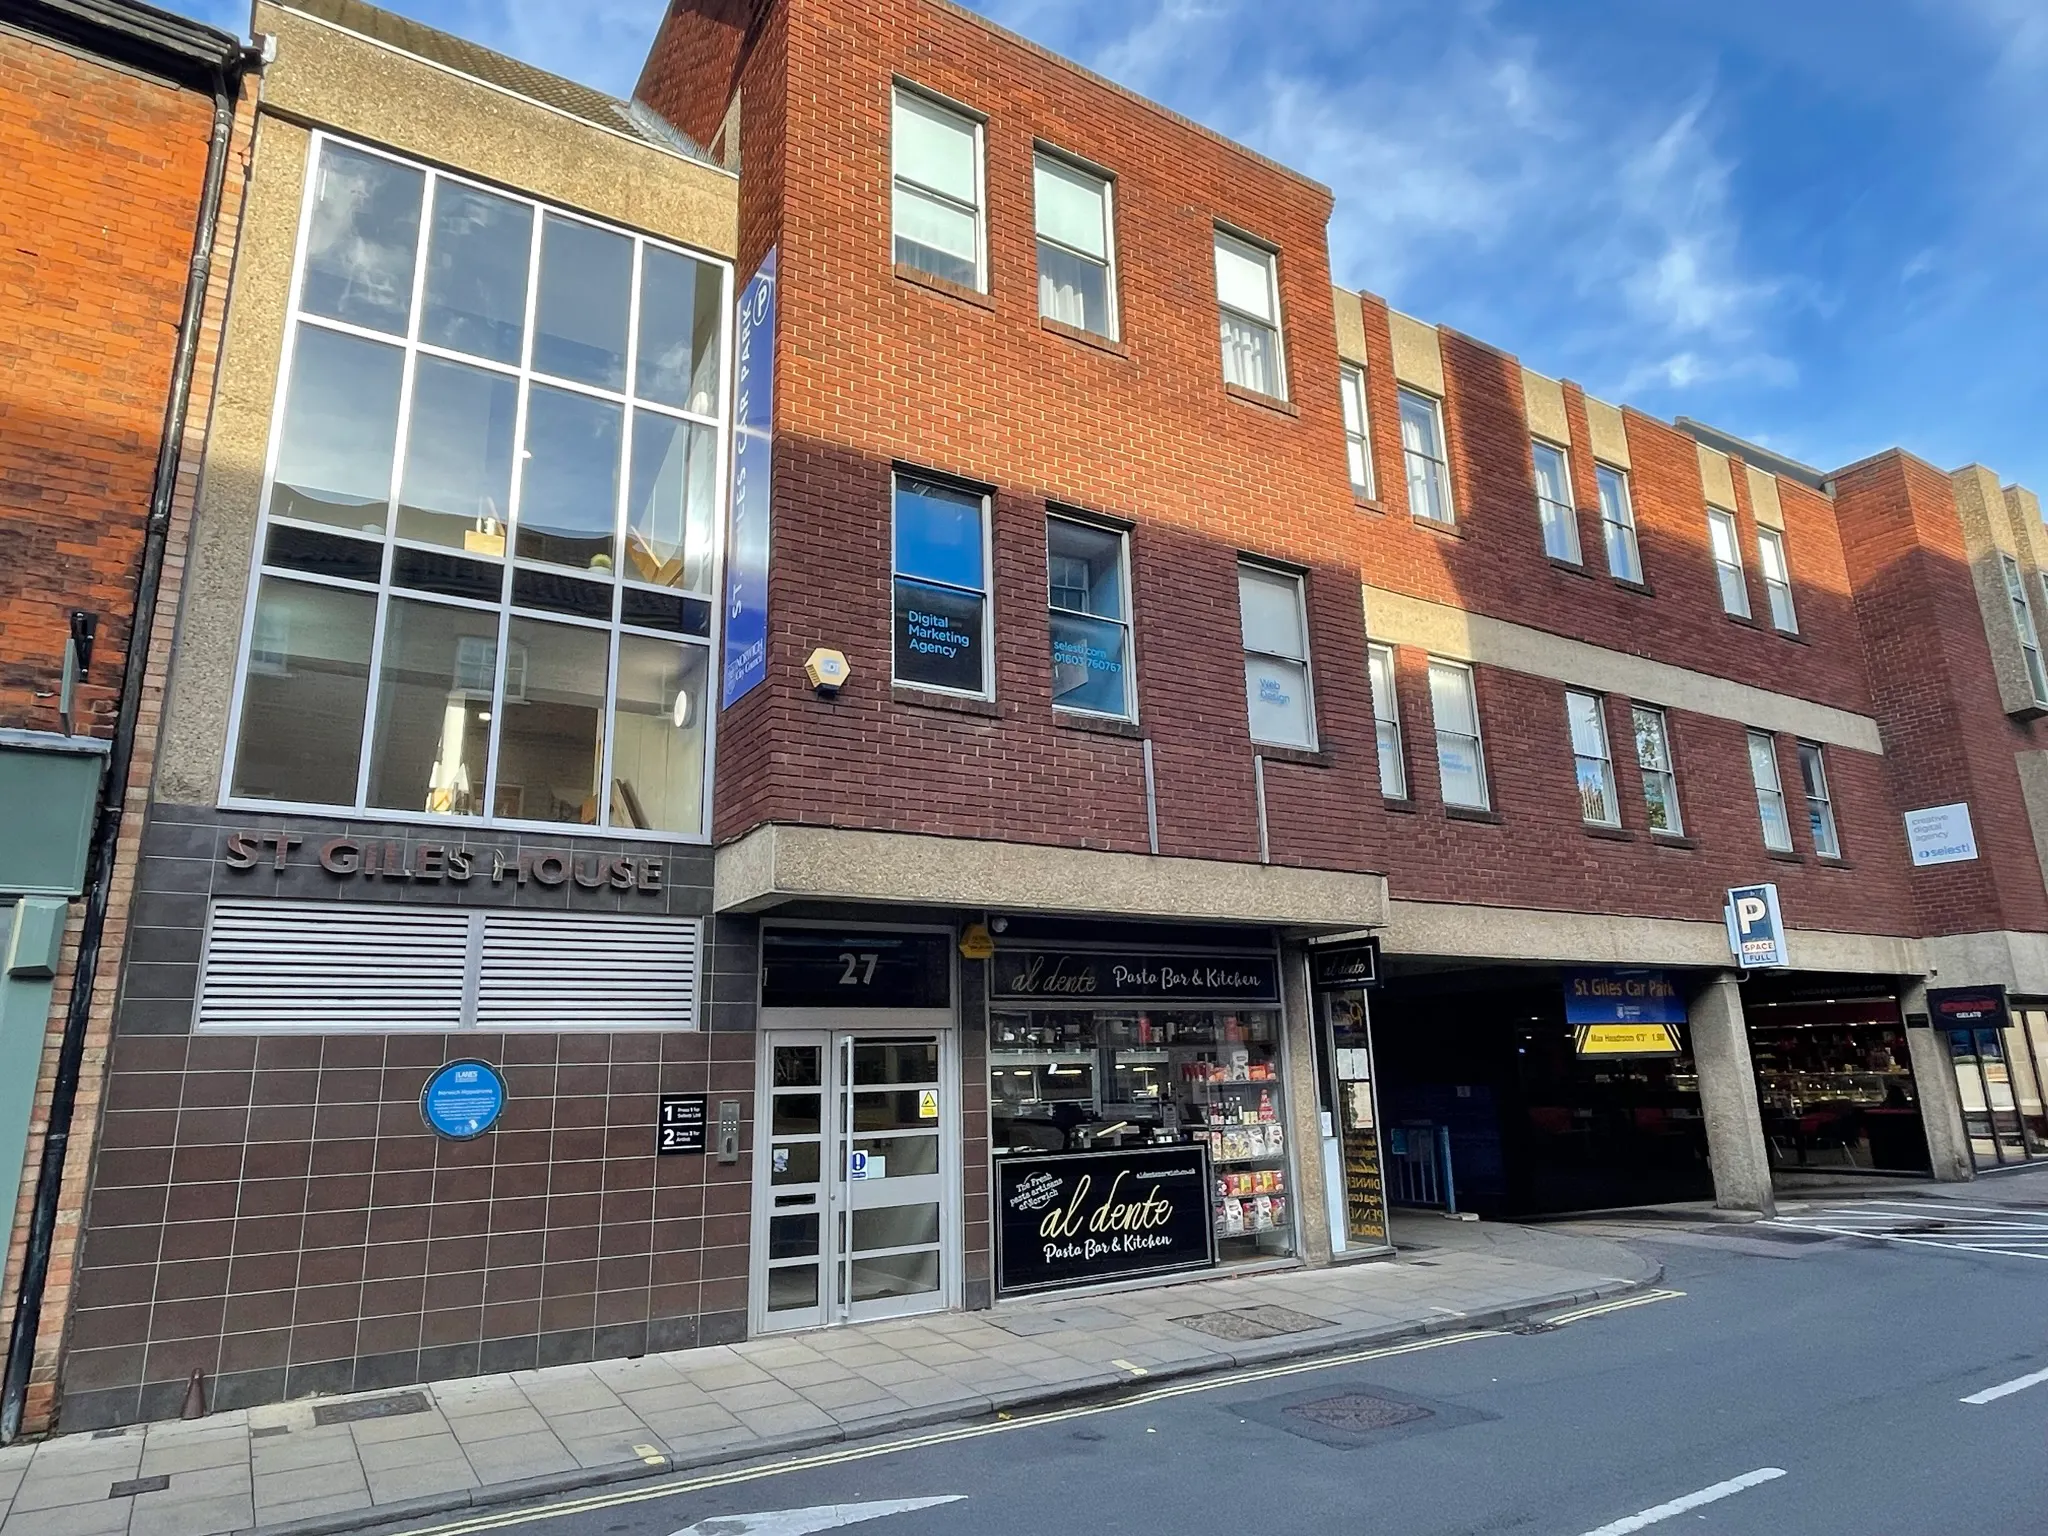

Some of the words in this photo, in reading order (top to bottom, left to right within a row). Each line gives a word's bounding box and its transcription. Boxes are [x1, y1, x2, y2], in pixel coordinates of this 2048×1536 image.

[741, 297, 752, 379] PARK
[737, 387, 749, 456] CAR
[908, 610, 949, 628] Digital
[908, 625, 970, 648] Marketing
[736, 638, 763, 668] NORWICH
[909, 638, 956, 658] Agency
[735, 664, 745, 681] City
[745, 652, 763, 673] Council
[1054, 652, 1085, 667] 01603
[1086, 656, 1122, 673] 760767
[1260, 676, 1281, 691] Web
[1260, 689, 1291, 705] Design
[1912, 814, 1949, 826] creative
[1913, 823, 1943, 834] digital
[1915, 831, 1950, 842] agency
[1931, 843, 1971, 857] selesti
[226, 833, 303, 871] ST
[319, 837, 477, 881] GILES
[492, 847, 664, 891] HOUSE
[1737, 898, 1766, 935] P
[1744, 942, 1773, 951] SPACE
[1749, 954, 1771, 962] FULL
[839, 953, 878, 986] 27
[1011, 956, 1043, 992] al
[1043, 955, 1098, 994] dente
[1112, 964, 1158, 988] Pasta
[1160, 966, 1189, 989] Bar
[1192, 969, 1204, 985] &
[1206, 965, 1262, 987] Kitchen
[1574, 979, 1589, 996] St
[1591, 978, 1622, 996] Giles
[1625, 979, 1645, 996] Car
[1649, 979, 1675, 997] Park
[664, 1106, 672, 1121] 1
[664, 1129, 674, 1145] 2
[1016, 1181, 1031, 1193] The
[1030, 1171, 1053, 1187] Fresh
[1010, 1191, 1031, 1207] pasta
[1031, 1178, 1063, 1196] artisans
[1028, 1189, 1059, 1207] Norwich
[1040, 1174, 1091, 1238] al
[1090, 1170, 1173, 1233] dente
[1043, 1243, 1083, 1263] Pasta
[1084, 1238, 1110, 1260] Bar
[1112, 1237, 1121, 1252] &
[1124, 1234, 1172, 1253] Kitchen
